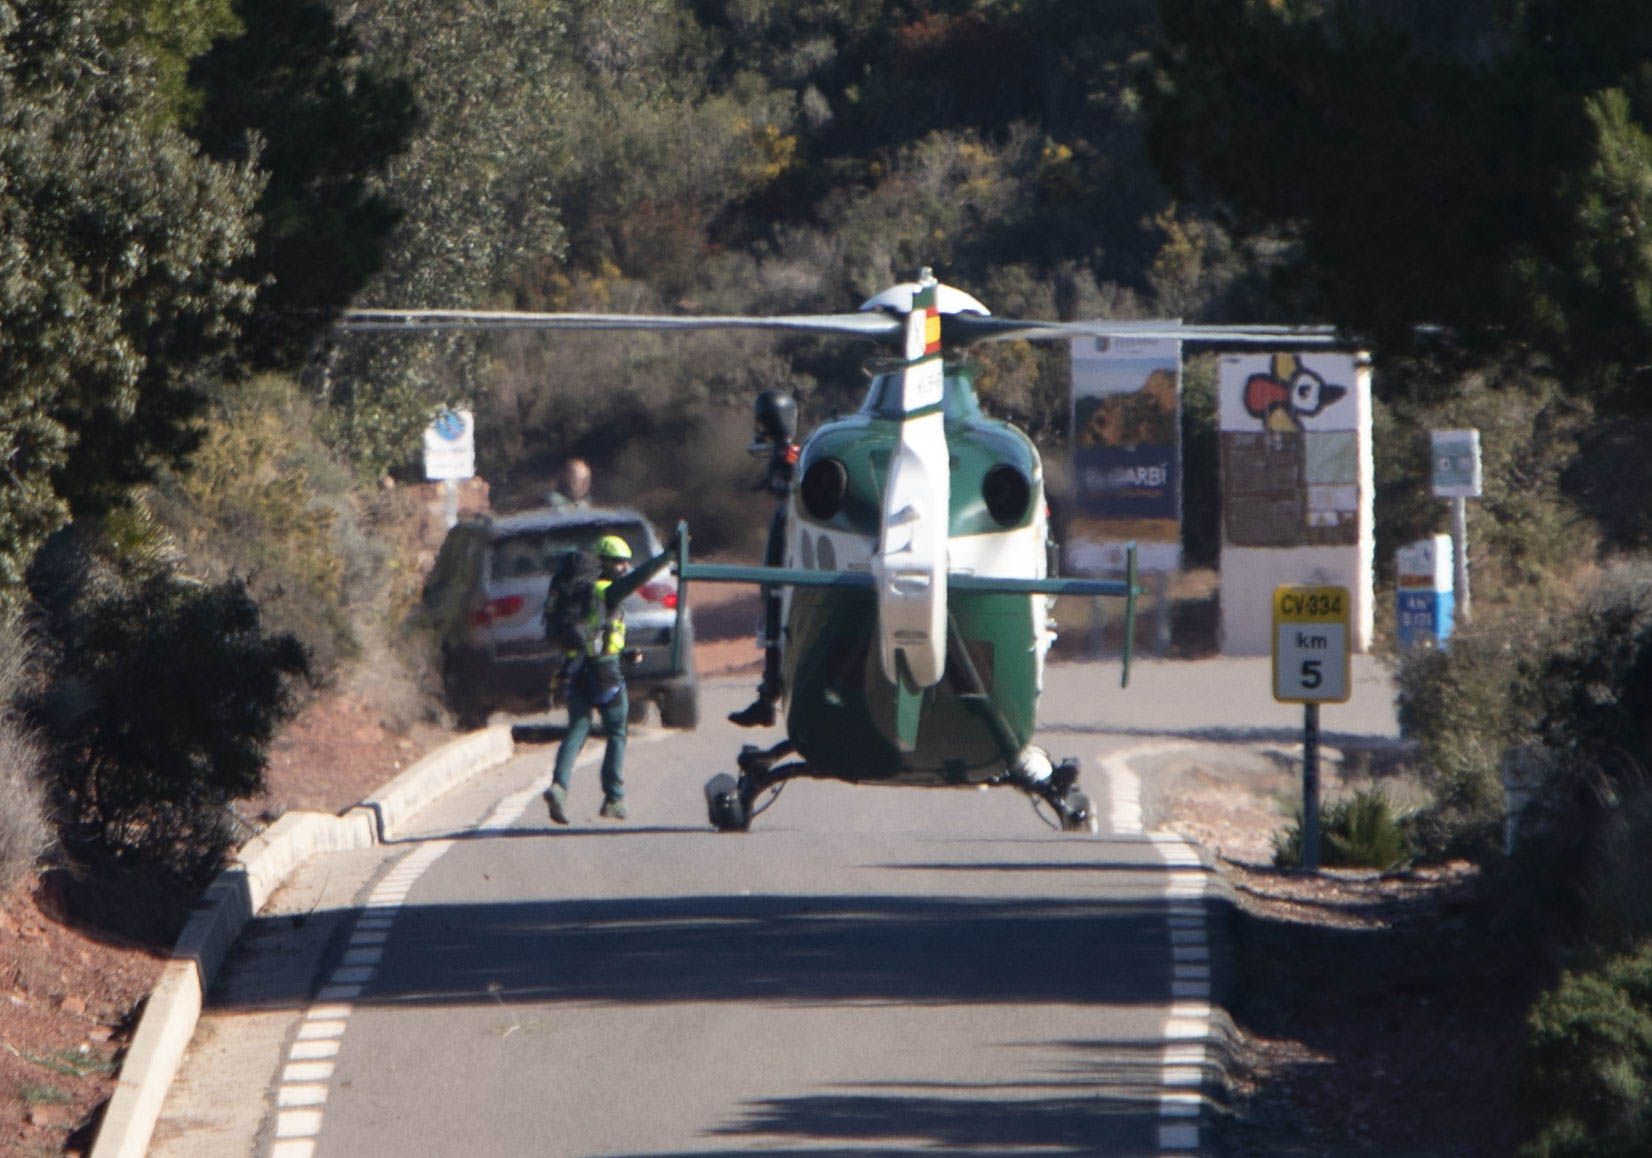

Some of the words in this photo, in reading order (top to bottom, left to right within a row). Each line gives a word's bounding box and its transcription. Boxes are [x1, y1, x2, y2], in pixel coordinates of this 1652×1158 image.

[1281, 594, 1343, 616] CV-334
[1296, 631, 1328, 650] km
[1301, 660, 1323, 690] 5
